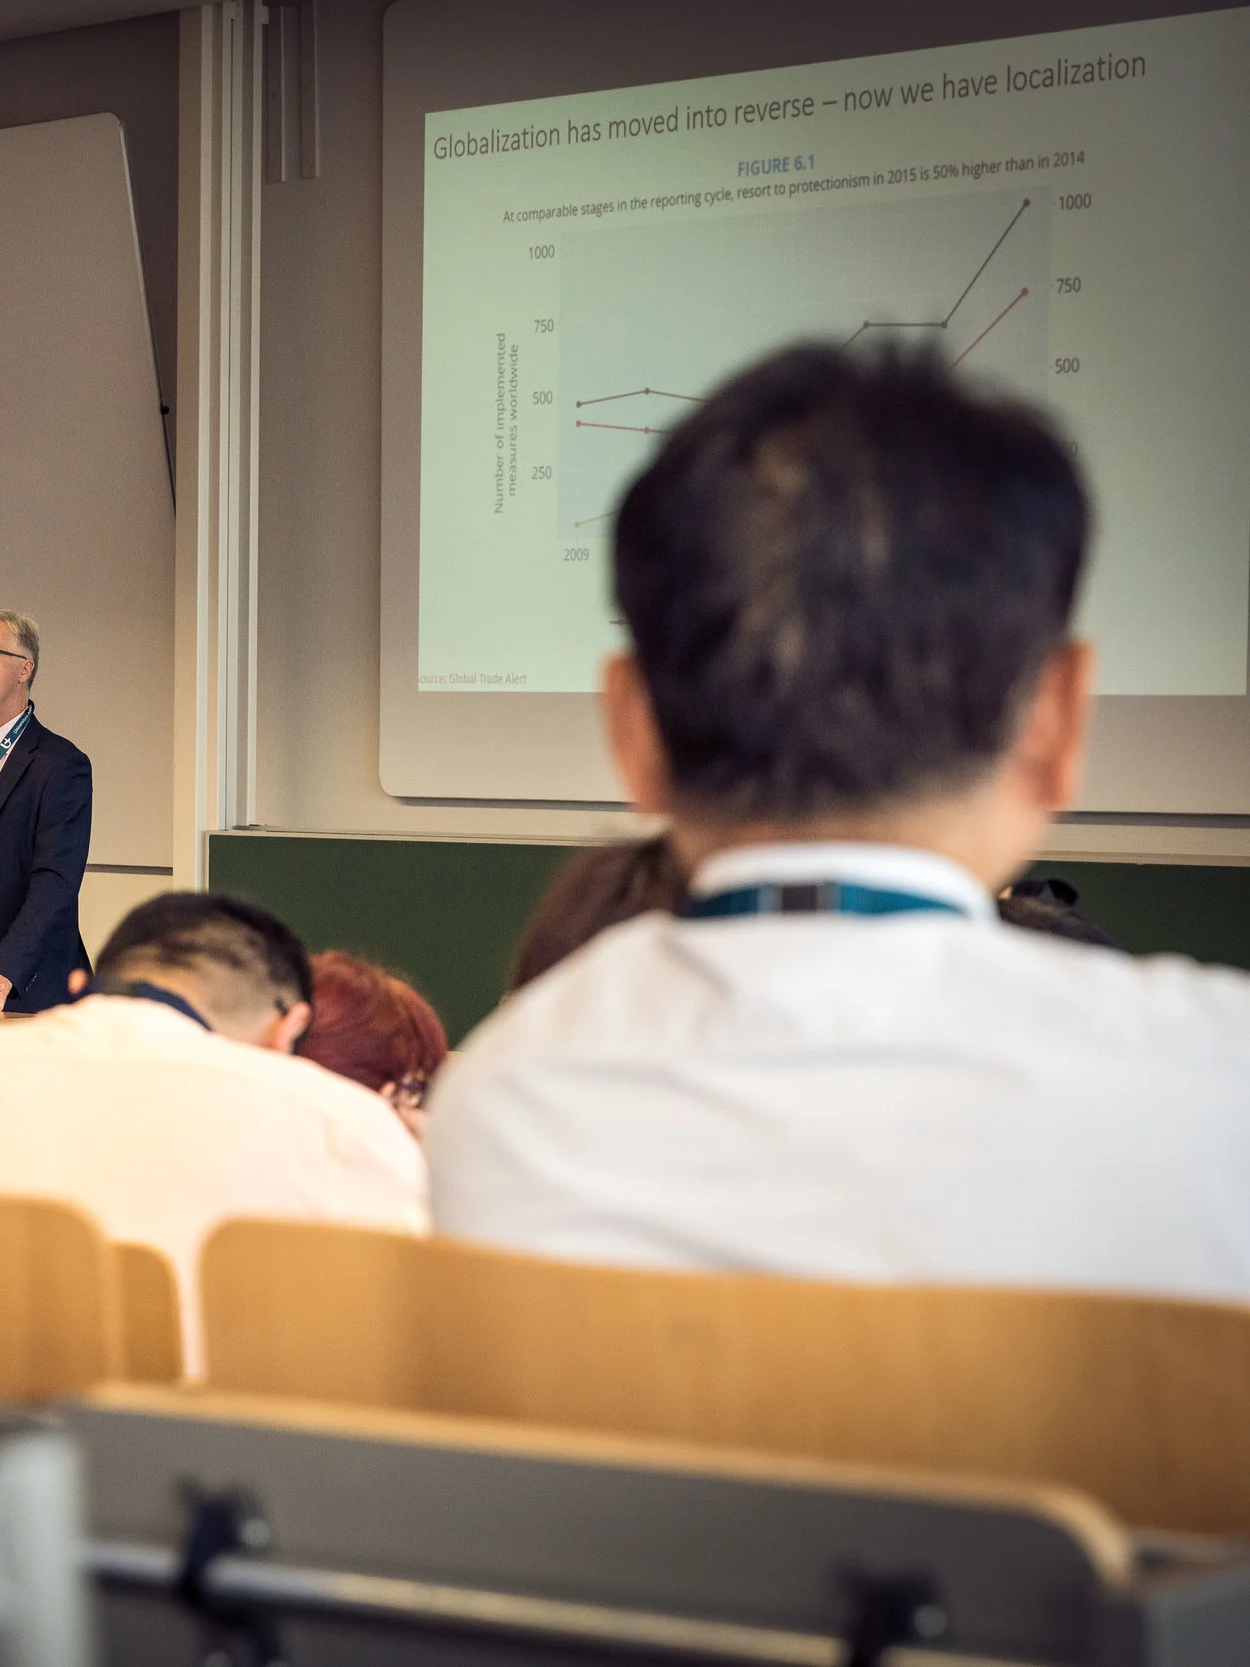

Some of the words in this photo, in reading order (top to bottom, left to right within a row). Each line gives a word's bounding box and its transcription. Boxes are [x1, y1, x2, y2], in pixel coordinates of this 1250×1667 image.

[434, 124, 560, 160] Globalization
[567, 119, 601, 145] has
[608, 106, 678, 140] moved
[686, 105, 726, 131] into
[734, 96, 814, 125] reverse
[844, 86, 893, 112] now
[900, 82, 934, 105] we
[942, 72, 997, 100] have
[1006, 52, 1145, 93] localization
[737, 156, 789, 177] FIGURE
[793, 154, 815, 171] 6.1
[503, 209, 515, 223] At
[516, 203, 578, 223] comparable
[581, 200, 614, 218] stages
[617, 198, 627, 211] in
[630, 196, 648, 210] the
[650, 190, 702, 213] reporting
[704, 186, 734, 207] cycle,
[737, 184, 770, 200] resort
[774, 182, 786, 196] to
[789, 171, 870, 197] protectionism
[873, 171, 885, 185] in
[887, 167, 917, 185] 2015
[920, 166, 930, 181] is
[933, 164, 959, 180] 50%
[961, 159, 1002, 180] higher
[1005, 156, 1034, 173] than
[1038, 154, 1050, 169] in
[1053, 150, 1085, 168] 2014
[1059, 193, 1092, 210] 1000
[528, 244, 555, 260] 1000
[1056, 276, 1082, 293] 750
[533, 318, 554, 333] 750
[1055, 357, 1080, 374] 500
[495, 332, 506, 430] implemented
[509, 343, 519, 421] worldwide
[532, 390, 553, 405] 500
[494, 435, 504, 449] of
[509, 424, 518, 497] measures
[531, 465, 552, 480] 250
[494, 453, 504, 514] Number
[563, 548, 590, 562] 2009
[418, 673, 447, 685] ource:
[449, 672, 477, 685] Global
[479, 672, 503, 685] Trade
[505, 672, 527, 685] Alert
